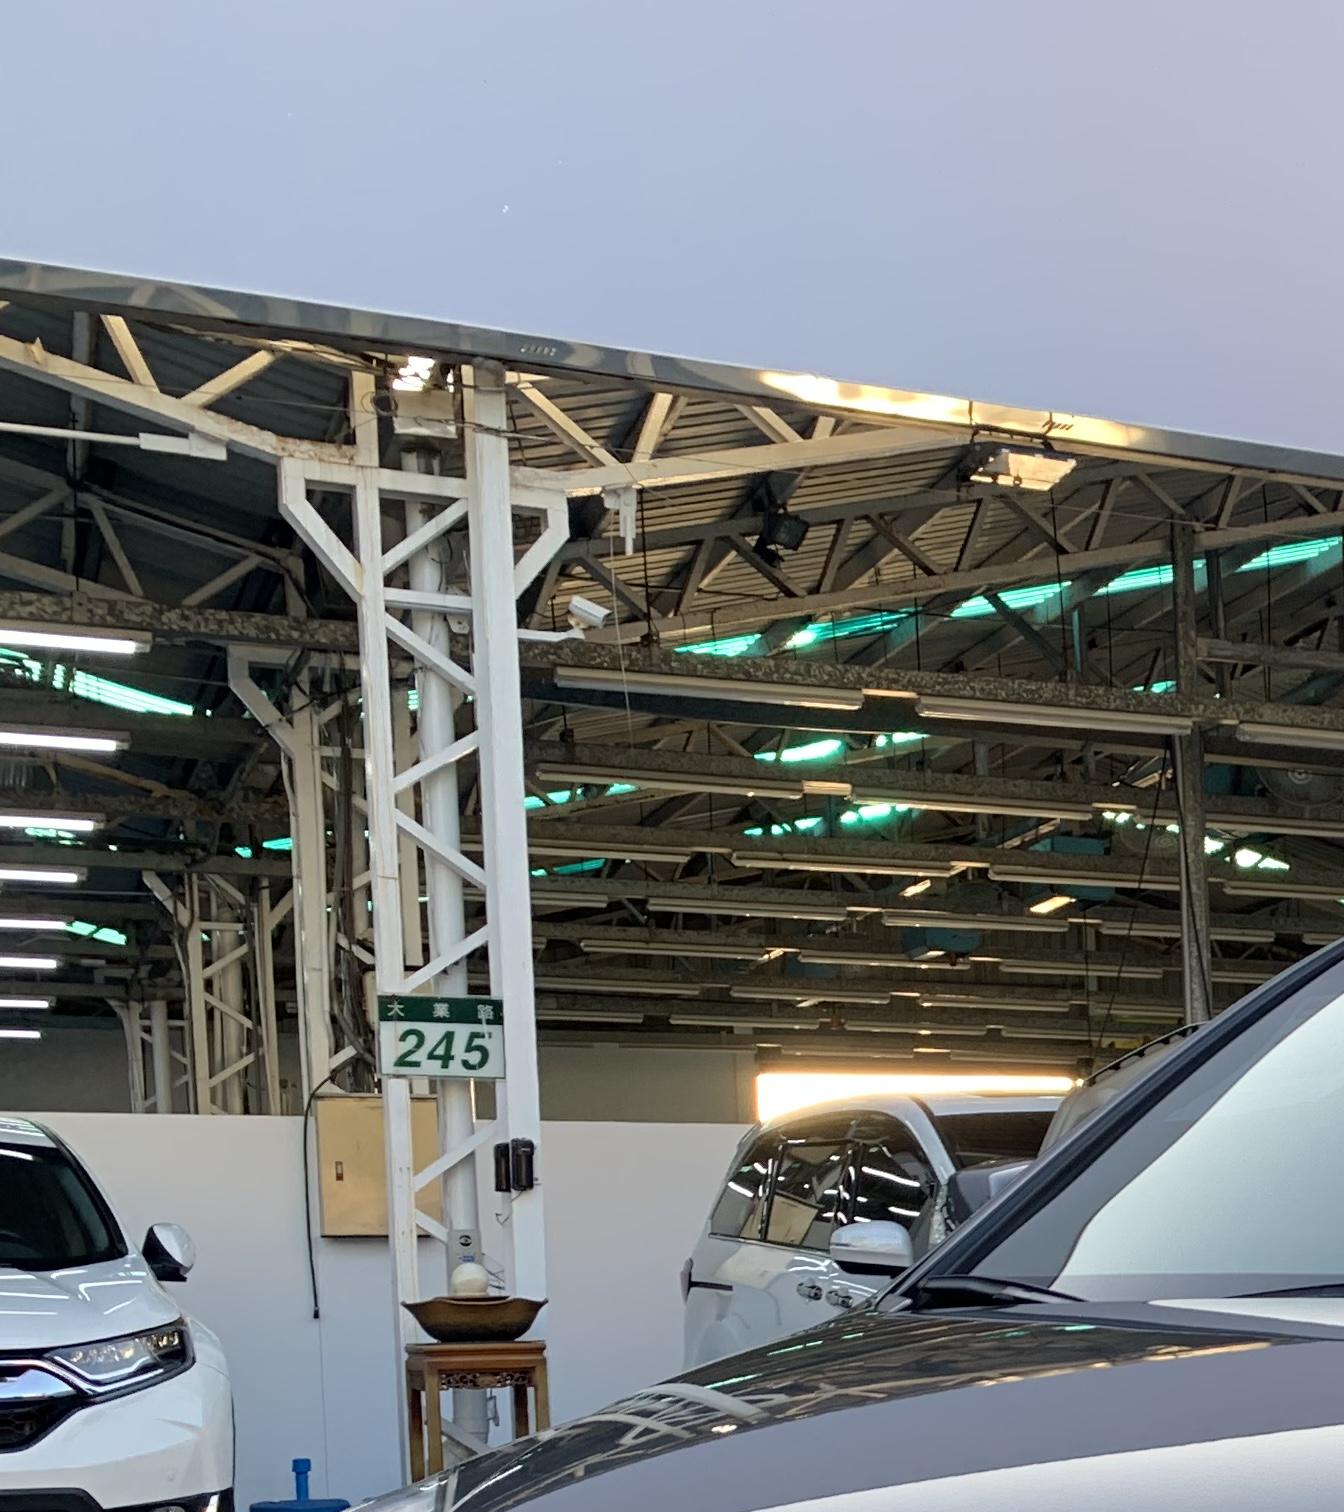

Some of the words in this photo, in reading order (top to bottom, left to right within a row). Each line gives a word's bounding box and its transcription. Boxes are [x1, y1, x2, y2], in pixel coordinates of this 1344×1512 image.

[386, 1002, 495, 1021] 大業路
[393, 1028, 490, 1071] 245
